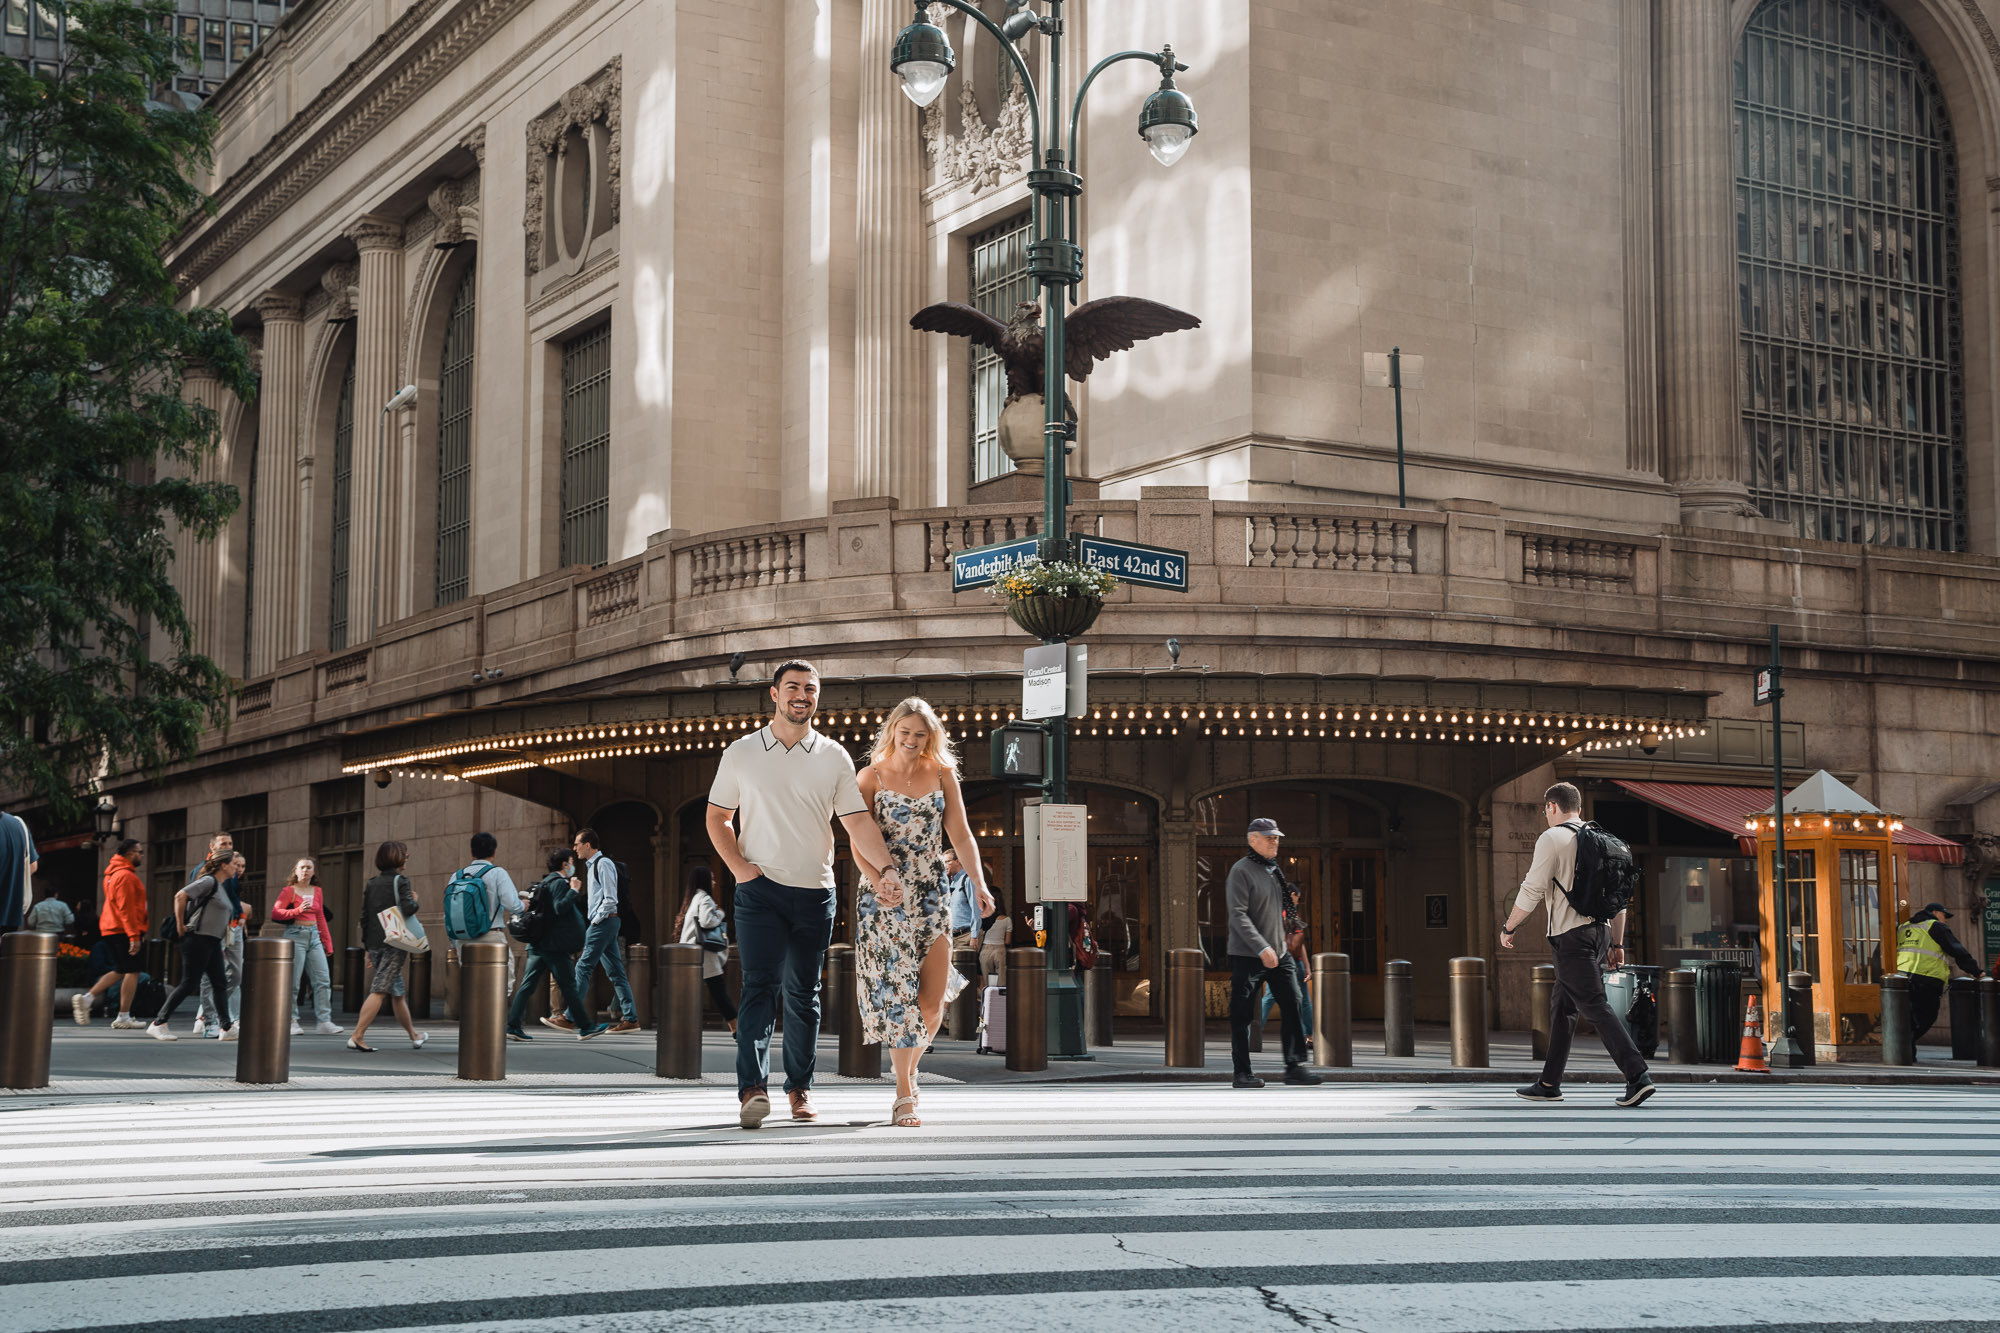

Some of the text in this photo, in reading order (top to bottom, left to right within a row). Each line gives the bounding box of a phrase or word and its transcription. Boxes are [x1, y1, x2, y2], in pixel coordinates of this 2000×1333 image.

[957, 554, 1013, 580] Vanderbilt
[1086, 548, 1180, 580] East 42nd St
[1028, 664, 1062, 677] Grand Central
[1028, 678, 1051, 687] Madison
[1508, 832, 1536, 840] GRAND
[1711, 951, 1753, 968] NEUHAU
